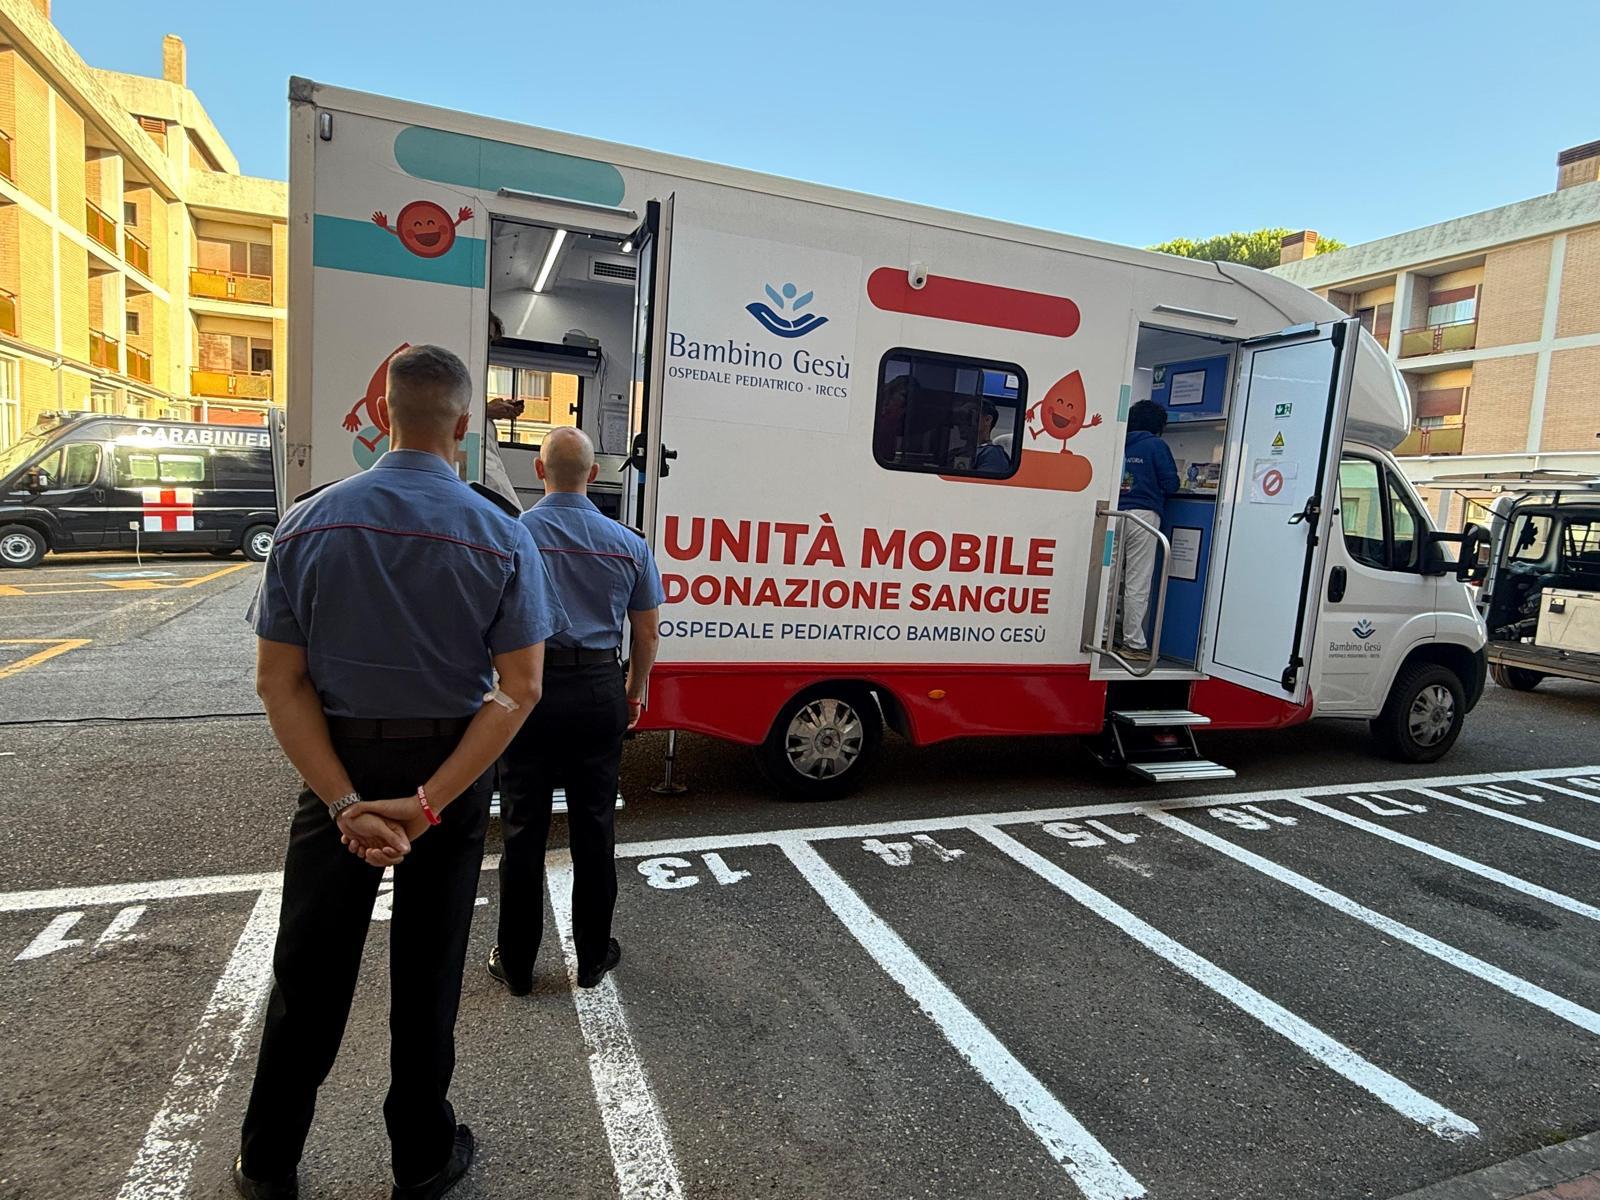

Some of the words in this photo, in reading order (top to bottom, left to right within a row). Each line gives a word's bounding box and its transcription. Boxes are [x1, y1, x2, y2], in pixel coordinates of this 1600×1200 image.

[669, 332, 783, 371] Bambino
[792, 349, 850, 380] Gesù
[668, 366, 732, 385] OSPEDALE
[735, 374, 804, 393] PEDIATRICO
[815, 383, 848, 399] IRCCS
[663, 512, 846, 569] UNITÀ
[860, 527, 1057, 577] MOBILE
[661, 573, 902, 611] DONAZIONE
[909, 582, 1050, 615] SANGUE
[658, 620, 775, 640] OSPEDALE
[780, 623, 901, 642] PEDIATRICO
[906, 625, 996, 643] BAMBINO
[999, 623, 1047, 644] GESÙ
[861, 833, 966, 867] 14
[1042, 819, 1142, 848] 15
[636, 852, 752, 890] 13
